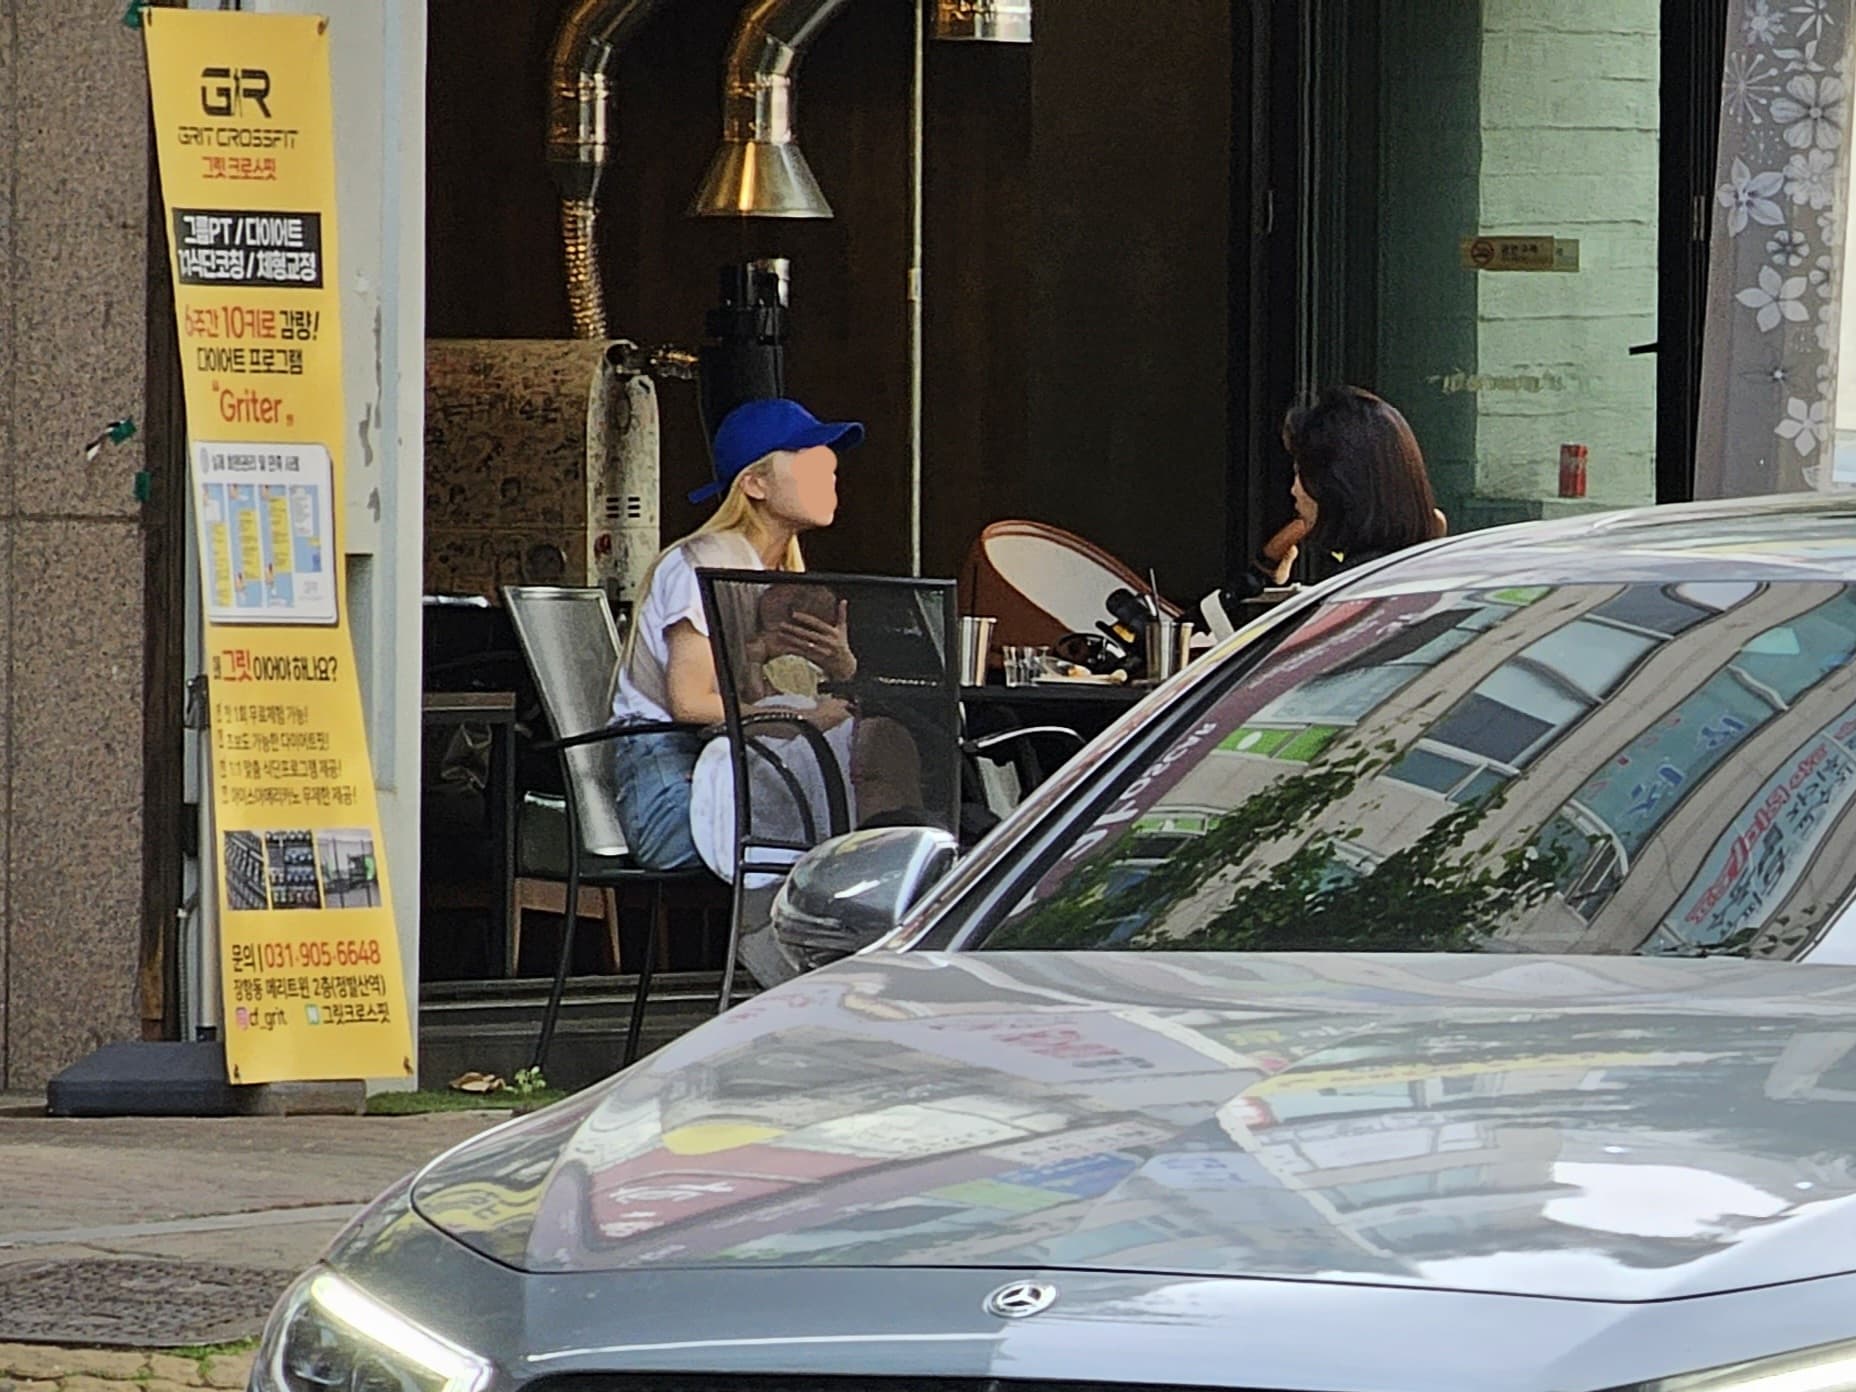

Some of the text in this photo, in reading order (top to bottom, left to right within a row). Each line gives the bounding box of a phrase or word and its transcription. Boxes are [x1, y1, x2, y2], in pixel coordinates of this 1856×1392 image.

[177, 125, 300, 150] GRIT CROSSFIT
[201, 156, 278, 181] 그릿 크로스핏
[245, 218, 304, 248] 다이어트
[256, 250, 317, 282] 체형교정
[278, 310, 321, 342] 감량!
[196, 347, 304, 377] 다이어트 프로그램
[232, 978, 263, 1002] 장항동
[321, 1003, 392, 1027] 그릿크로스핏
